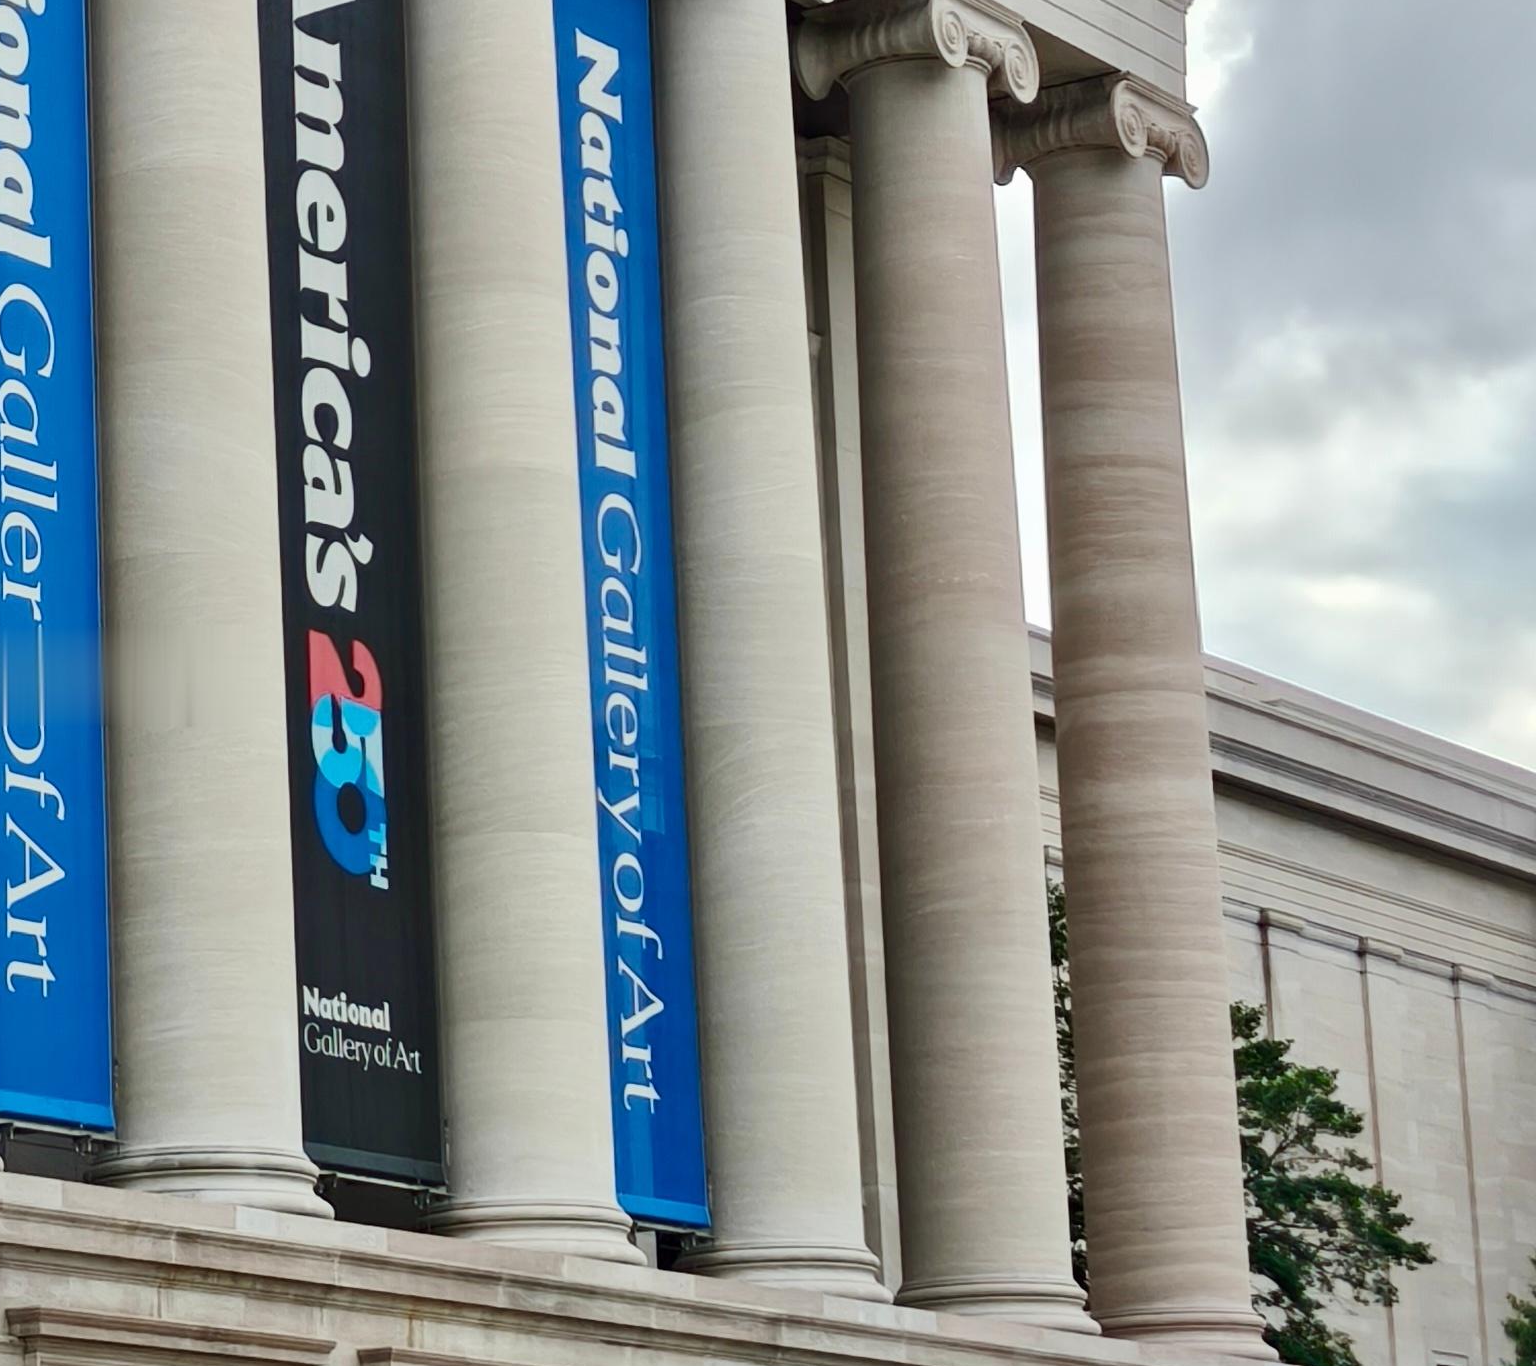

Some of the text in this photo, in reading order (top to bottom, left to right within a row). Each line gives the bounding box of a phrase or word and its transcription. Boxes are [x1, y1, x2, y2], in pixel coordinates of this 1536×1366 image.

[575, 28, 664, 1113] National Gallery of Art
[6, 814, 65, 997] Art
[302, 984, 391, 1032] National
[304, 1022, 423, 1074] Gallery of Art
